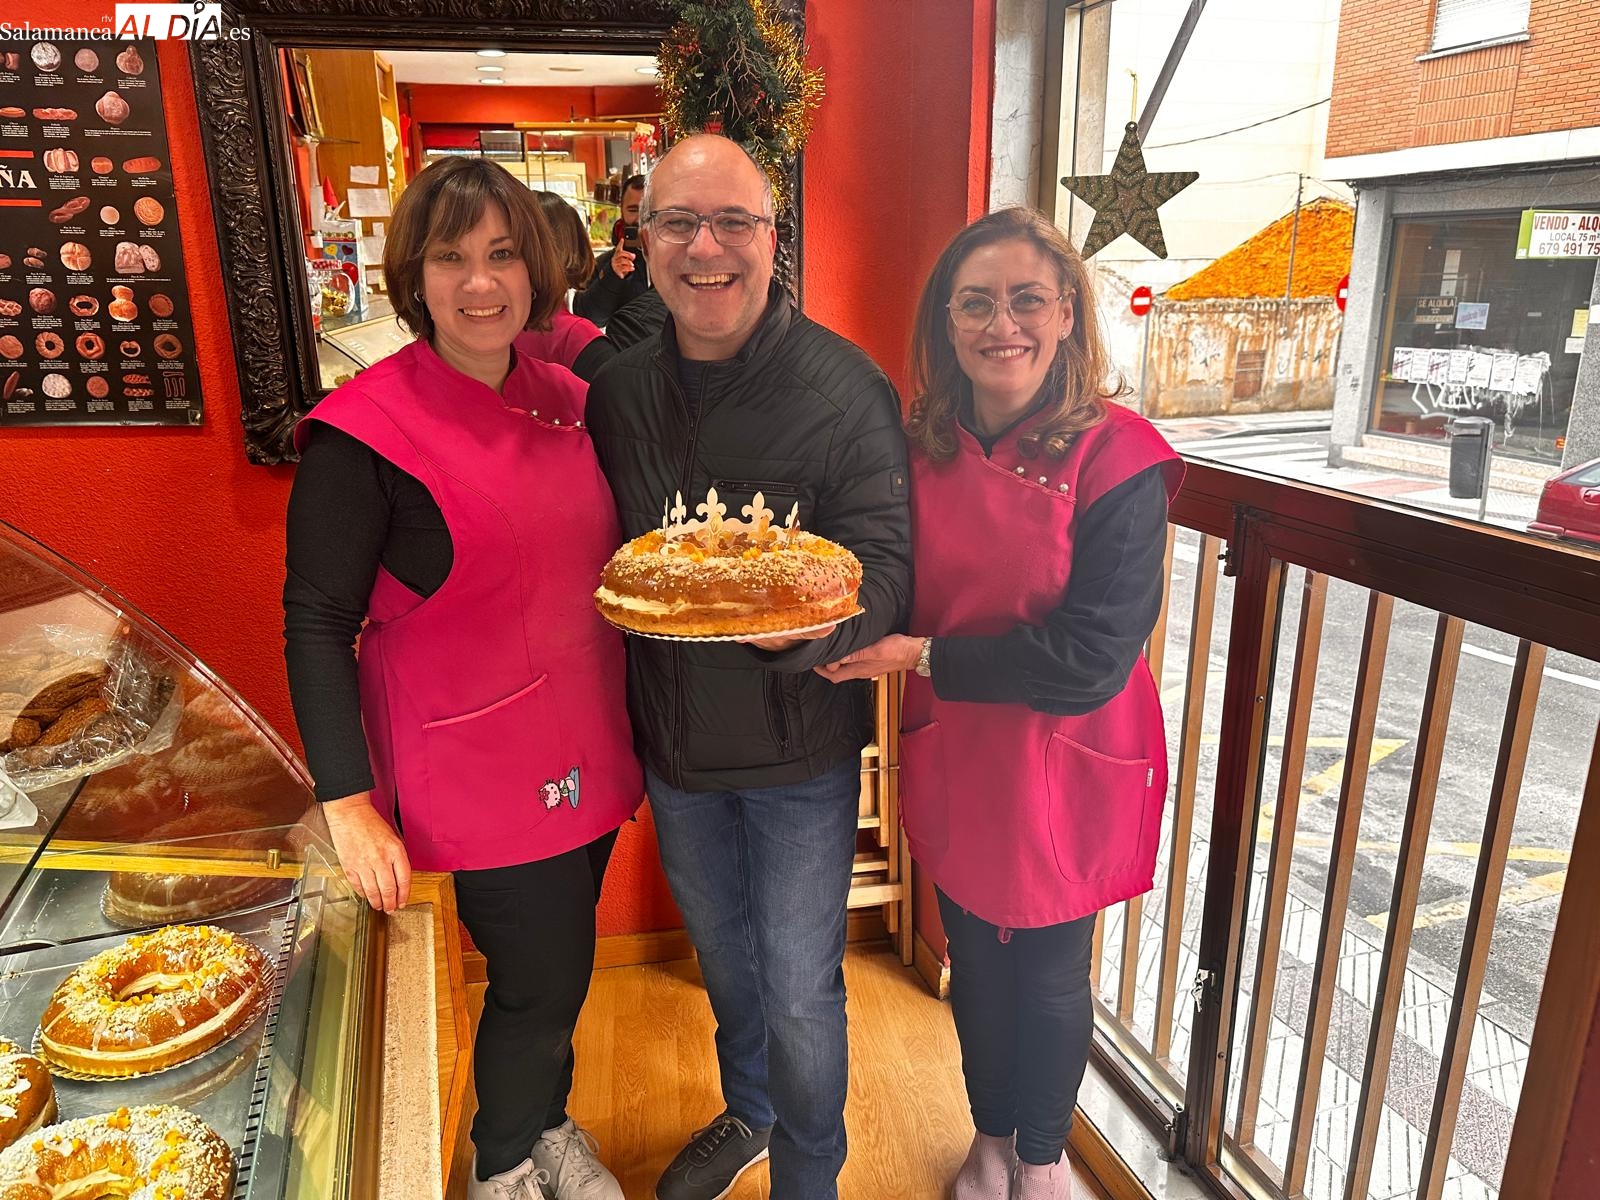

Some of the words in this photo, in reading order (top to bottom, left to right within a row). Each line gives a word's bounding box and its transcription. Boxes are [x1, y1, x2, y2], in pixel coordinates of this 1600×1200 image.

[1534, 215, 1569, 230] VENDO
[1578, 215, 1600, 232] ALQ
[1549, 232, 1577, 242] LOCAL
[1578, 232, 1588, 242] 75
[1538, 242, 1560, 255] 679
[1563, 242, 1583, 255] 491
